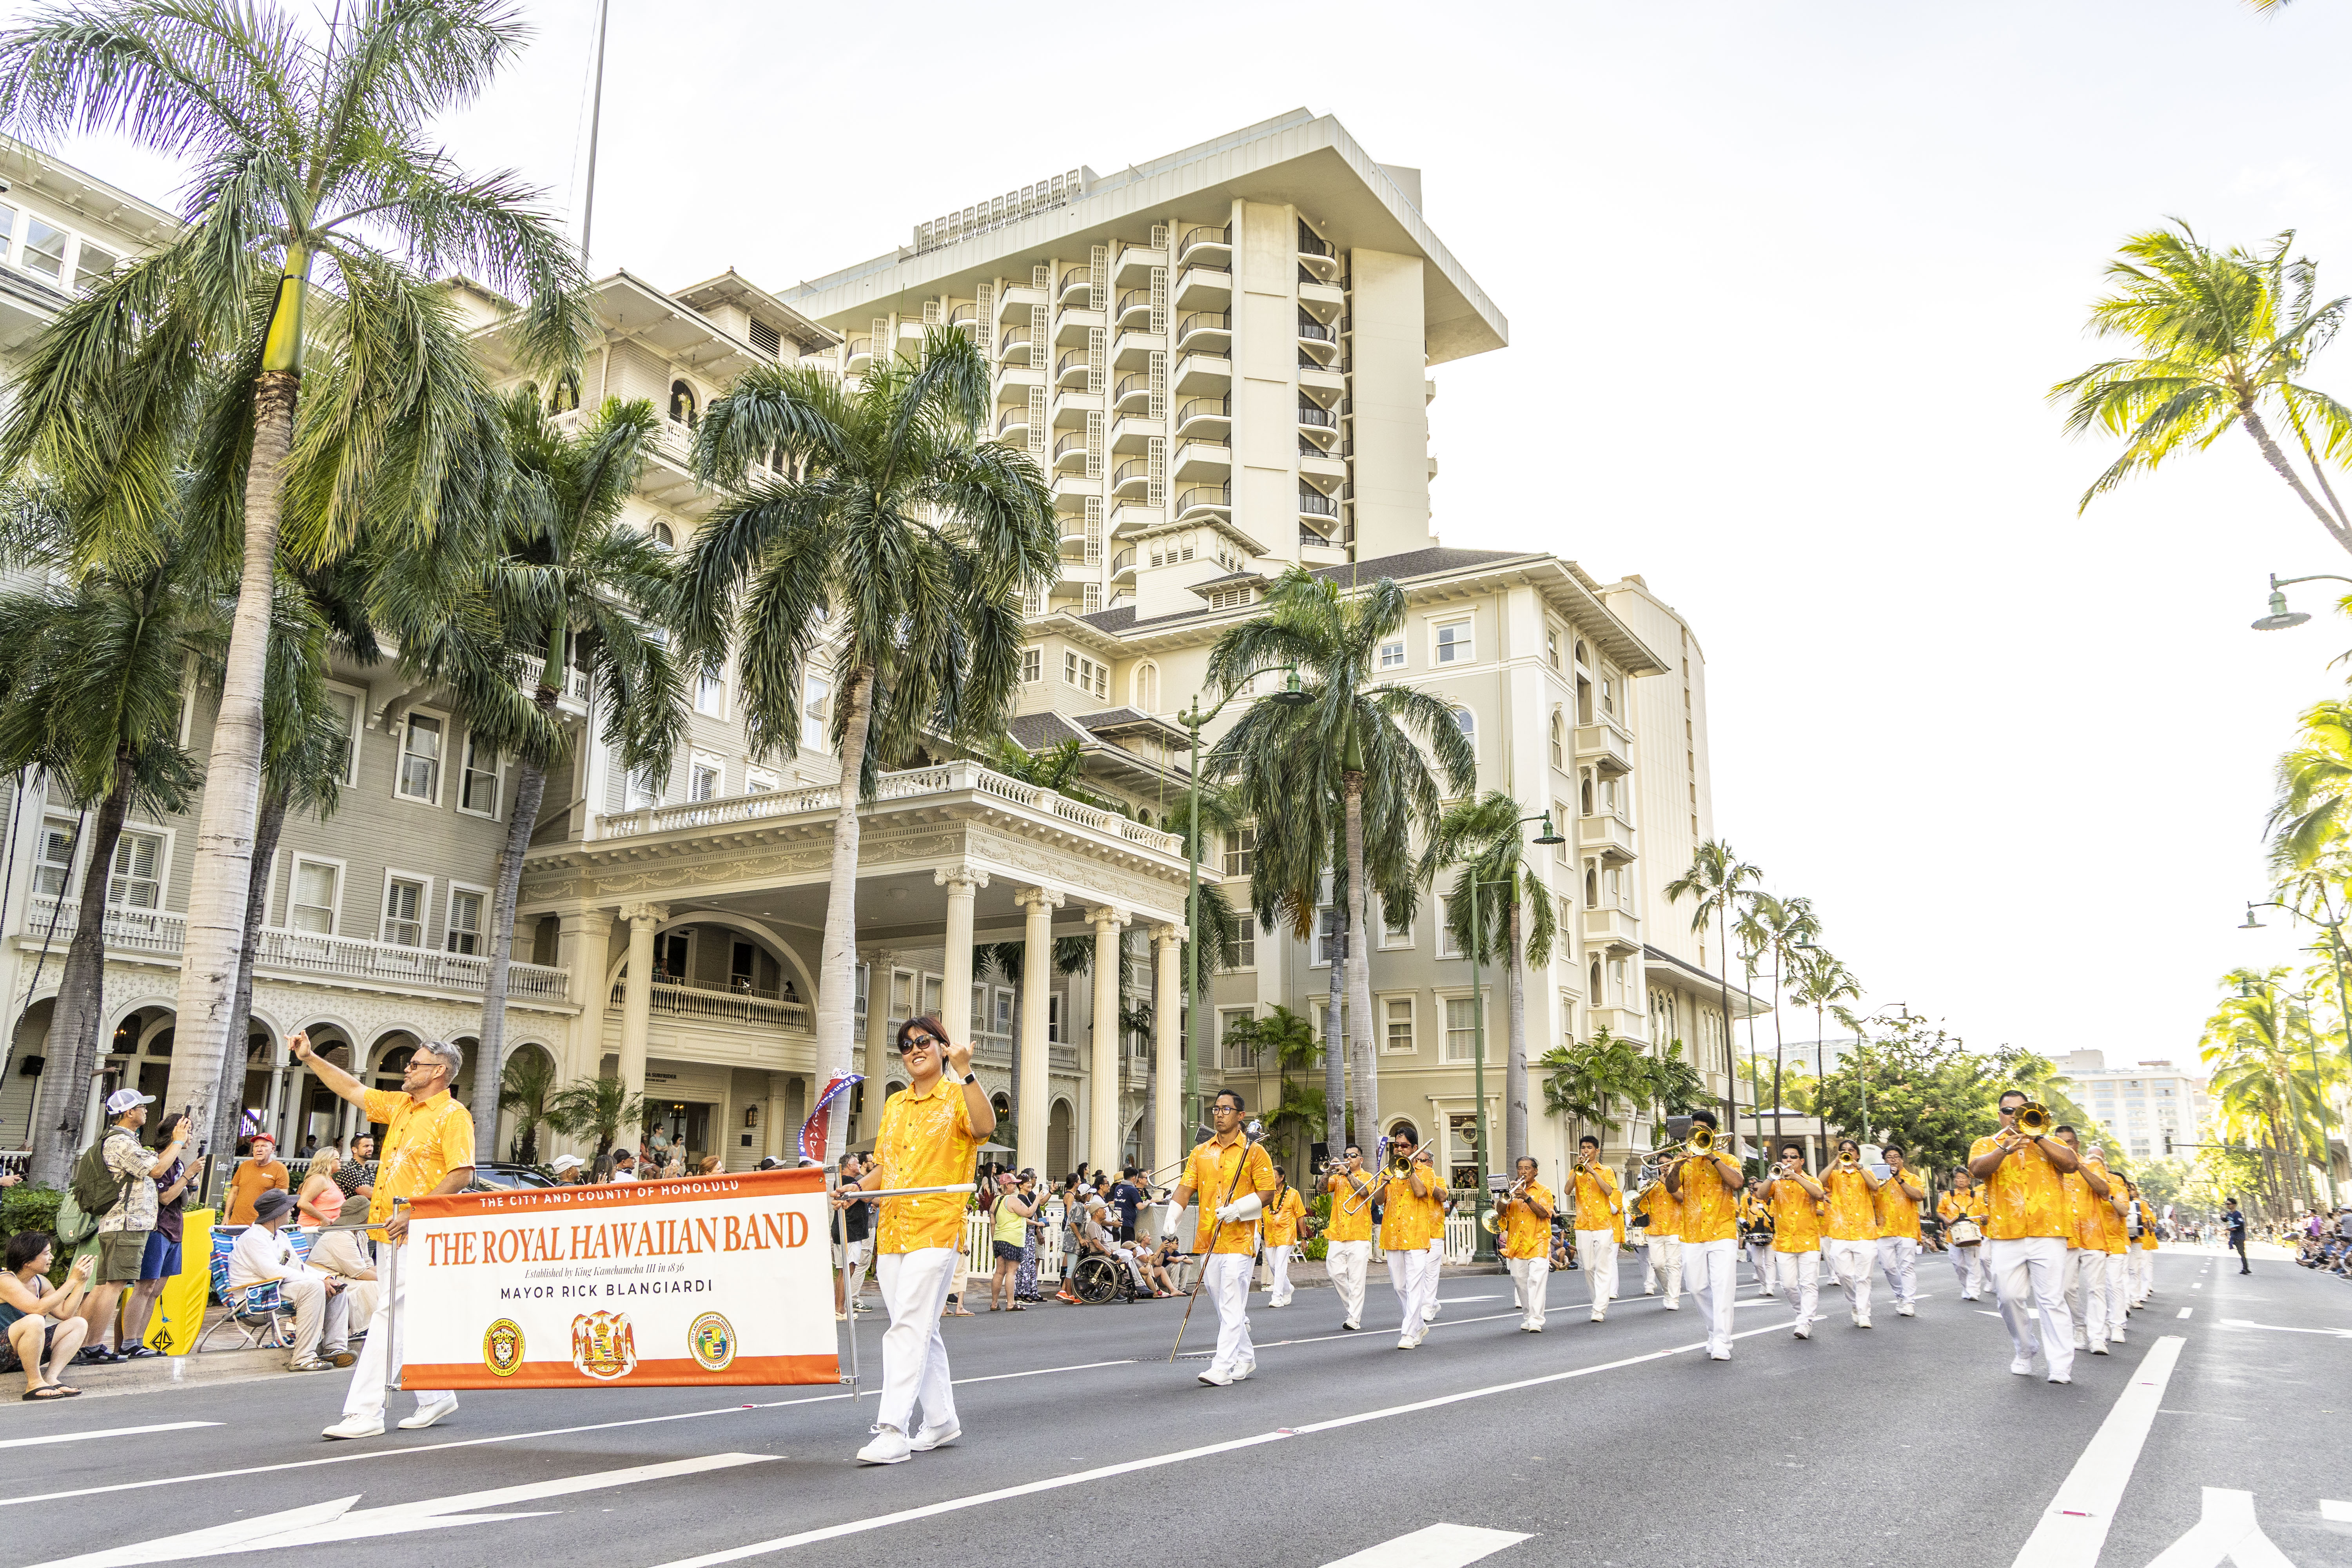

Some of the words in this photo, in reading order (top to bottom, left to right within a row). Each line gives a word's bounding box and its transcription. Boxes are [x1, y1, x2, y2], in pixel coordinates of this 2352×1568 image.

[1460, 1123, 1472, 1136] HONLULU
[480, 1197, 504, 1208] THE
[510, 1195, 537, 1206] CITY
[544, 1192, 571, 1204] AND
[577, 1189, 630, 1201] COUNTY
[637, 1187, 654, 1197] OF
[661, 1180, 739, 1196] HONOLULU
[425, 1232, 477, 1266] THE
[482, 1227, 565, 1264] ROYAL
[570, 1217, 718, 1260] HAWAIIAN
[723, 1211, 808, 1252] BAND
[525, 1268, 563, 1279] Established
[565, 1267, 573, 1279] by
[575, 1267, 592, 1278] King
[593, 1264, 644, 1276] Kamehameha
[646, 1263, 657, 1274] III
[658, 1263, 665, 1272] in
[668, 1262, 684, 1273] 1836
[501, 1287, 554, 1299] MAYOR
[562, 1285, 597, 1298] RICK
[606, 1279, 711, 1296] BLANGIARDI
[513, 1325, 524, 1349] HONOLULU
[721, 1319, 733, 1342] HONOLULU
[490, 1364, 500, 1374] STATE
[506, 1364, 519, 1374] HAWAII
[700, 1358, 710, 1368] STATE
[718, 1358, 730, 1368] HAWAII
